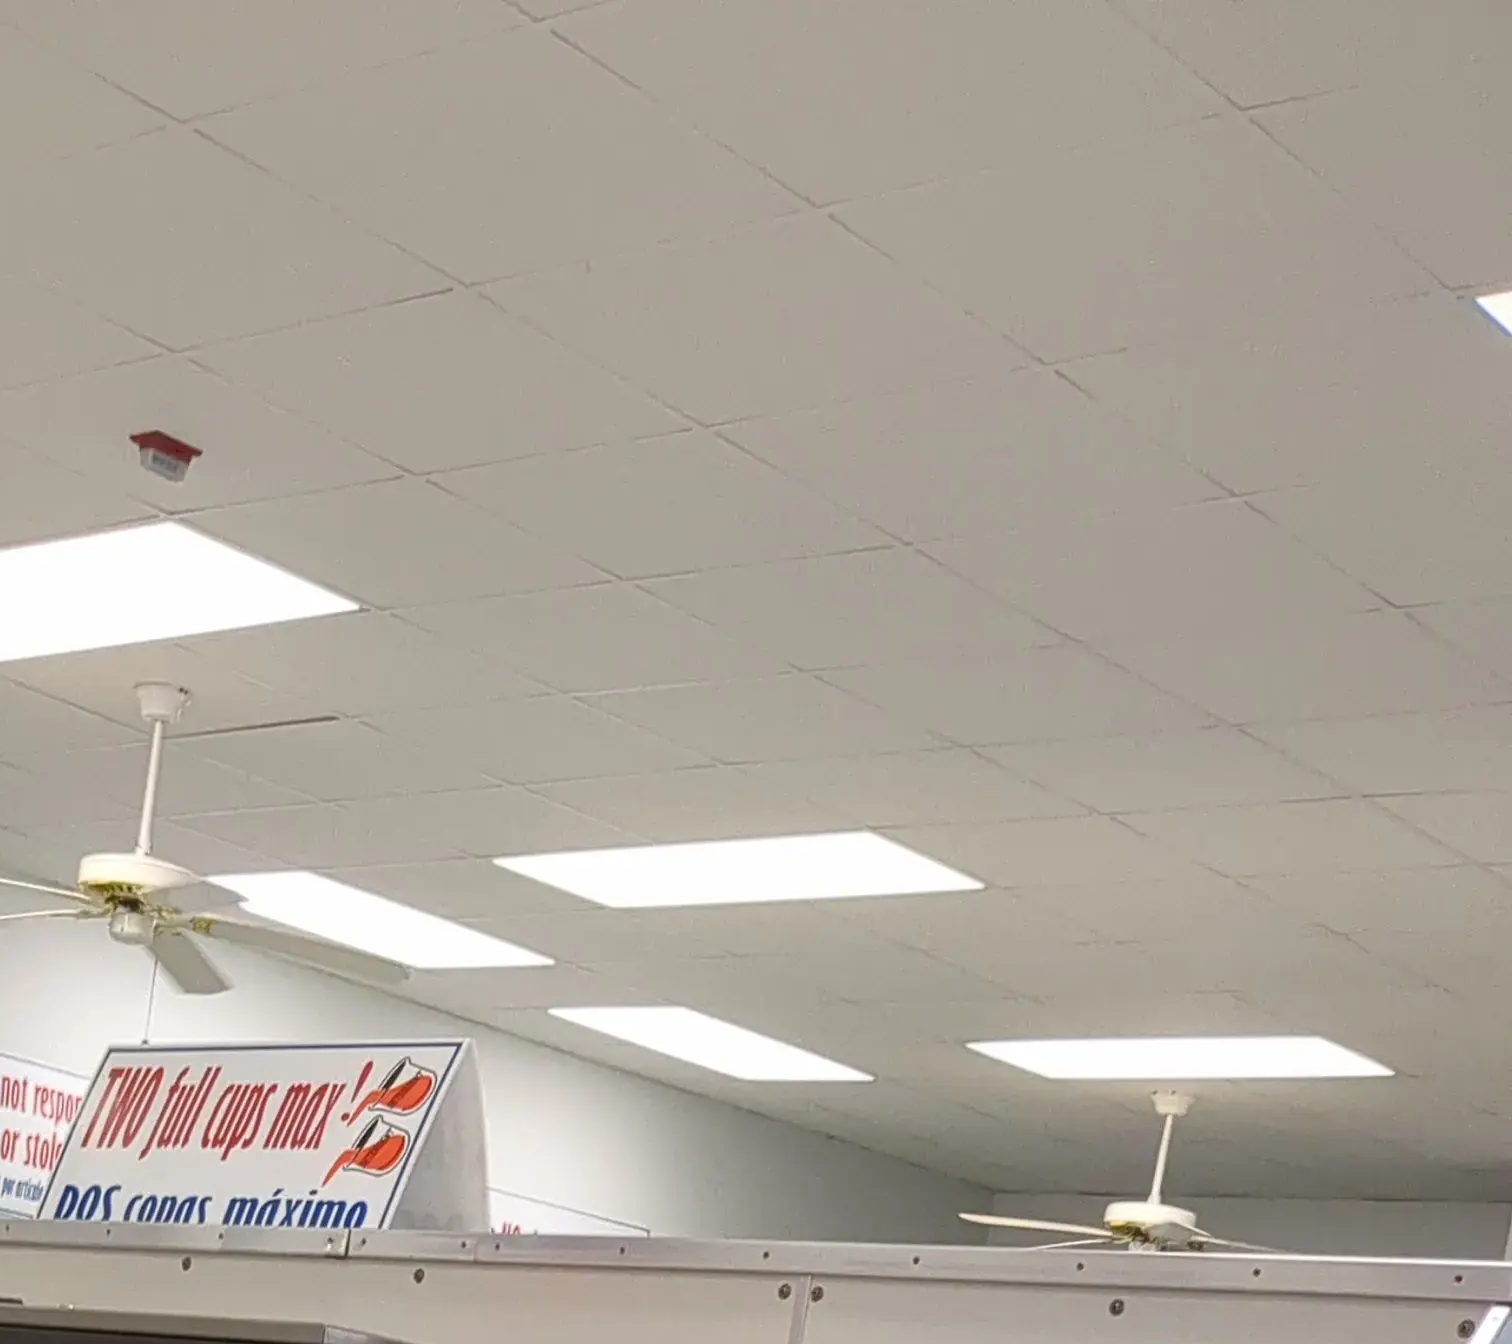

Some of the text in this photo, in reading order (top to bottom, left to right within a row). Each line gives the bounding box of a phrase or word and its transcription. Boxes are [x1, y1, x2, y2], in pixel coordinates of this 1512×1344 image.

[0, 1074, 27, 1113] not
[80, 1066, 165, 1149] TWO
[137, 1065, 223, 1161] full
[201, 1083, 278, 1162] cups
[0, 1128, 21, 1163] or
[53, 1184, 122, 1222] DOS
